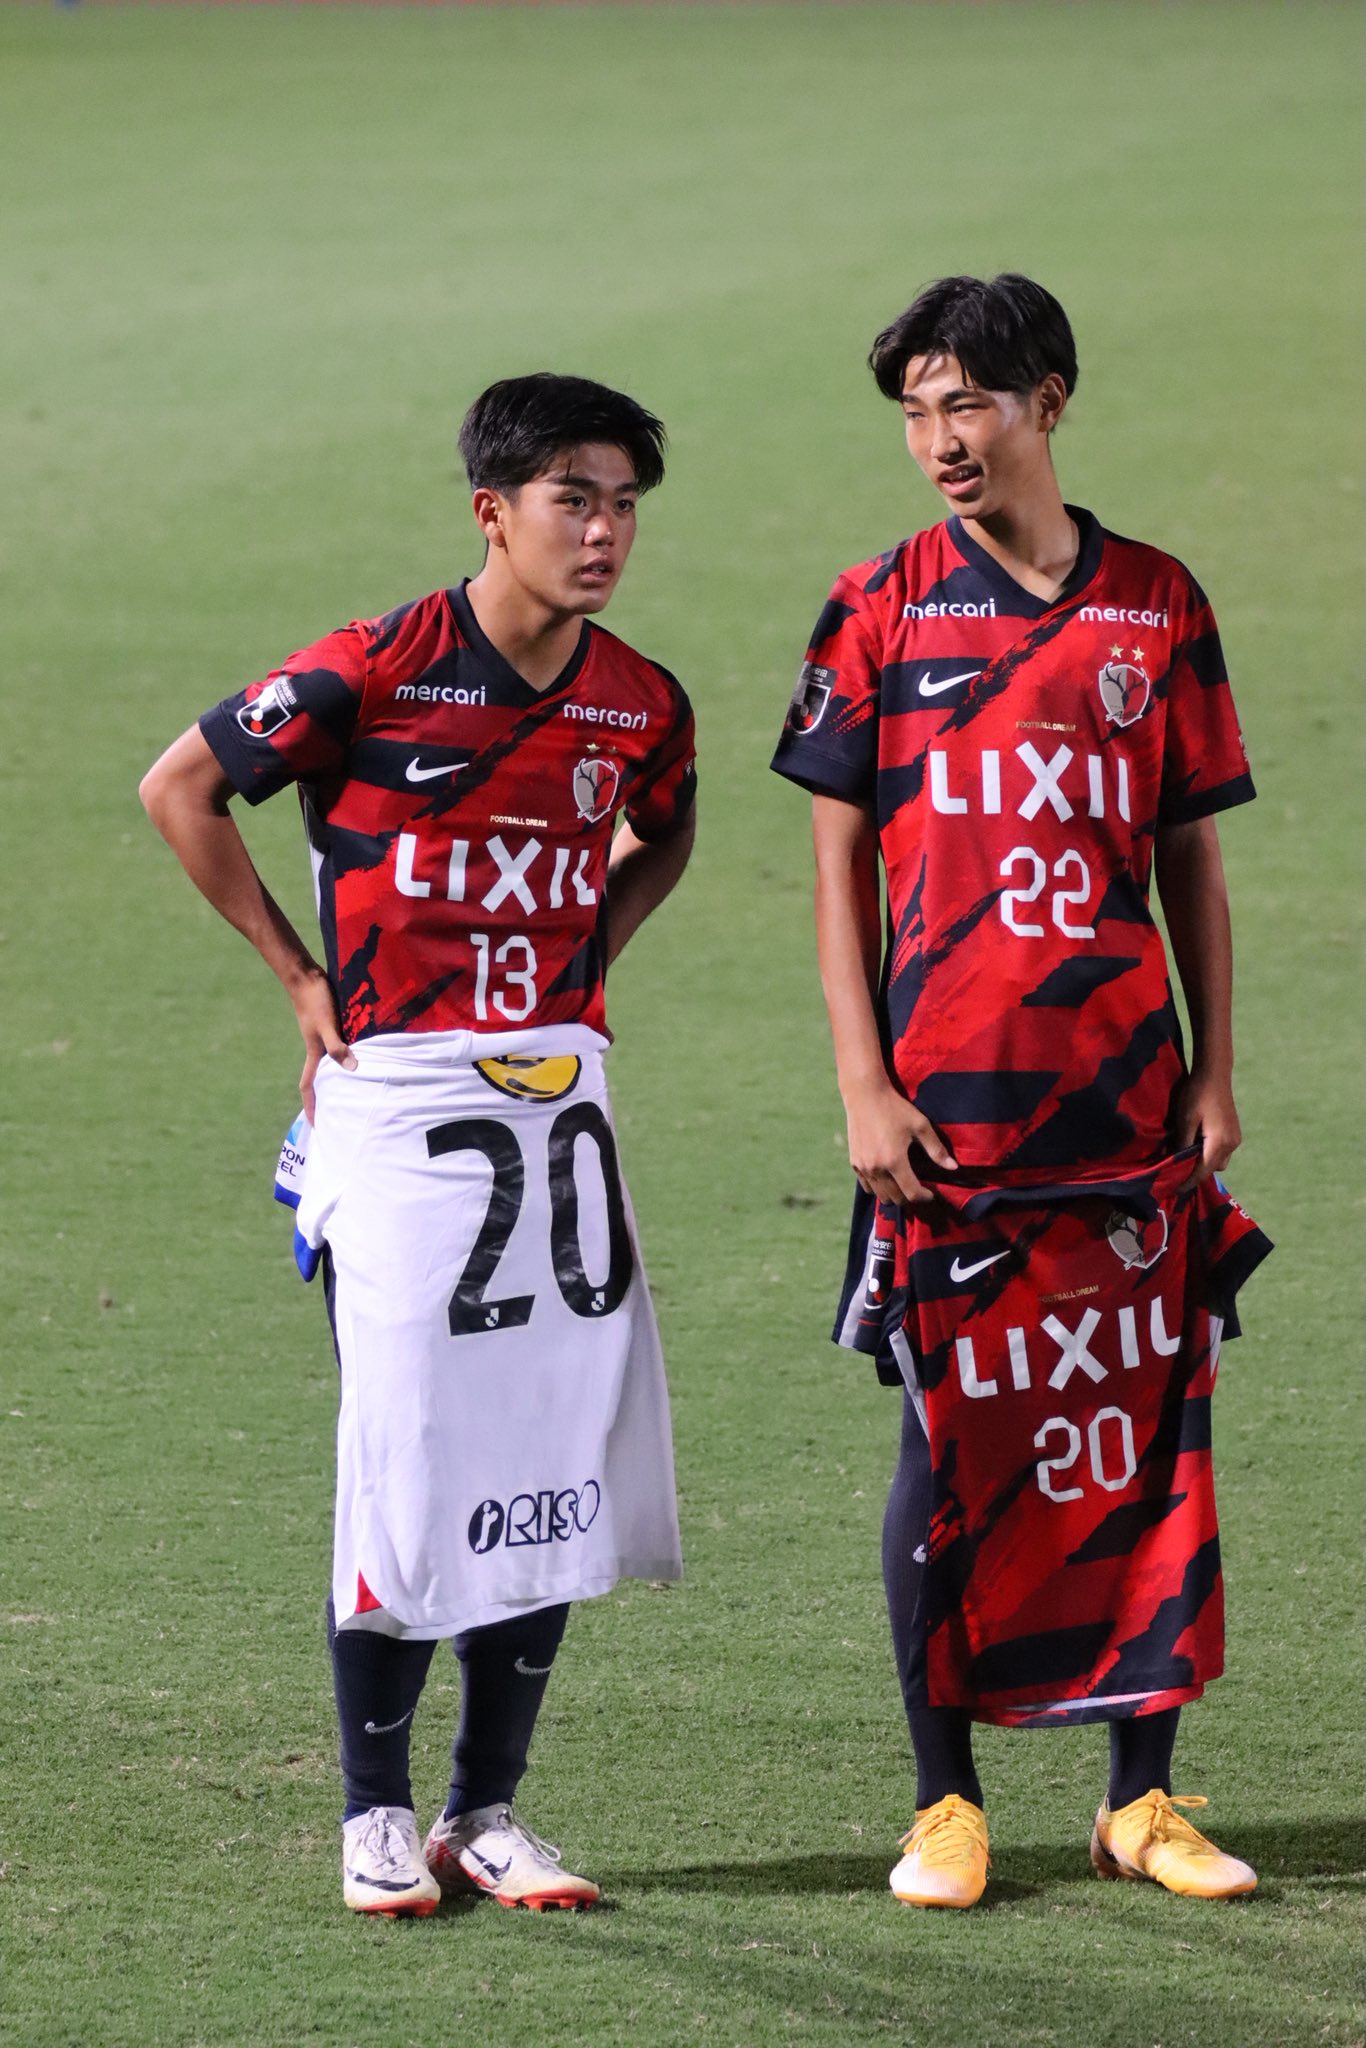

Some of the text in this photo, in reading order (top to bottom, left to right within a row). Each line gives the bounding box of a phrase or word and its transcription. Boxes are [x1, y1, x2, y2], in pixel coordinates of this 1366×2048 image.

[903, 597, 996, 620] mercari
[1079, 606, 1169, 629] mercari
[395, 685, 486, 706] mercari
[563, 703, 648, 731] mercari
[1015, 721, 1077, 732] FOOTBALL DREAM
[490, 814, 548, 828] FOOTBALL DREAM
[394, 832, 597, 916] LIXIL
[999, 846, 1096, 939] 22
[470, 933, 538, 1022] 13
[425, 1101, 634, 1336] 20
[1075, 1284, 1100, 1298] DREAM
[955, 1295, 1181, 1399] LIXIL
[1033, 1406, 1137, 1503] 20
